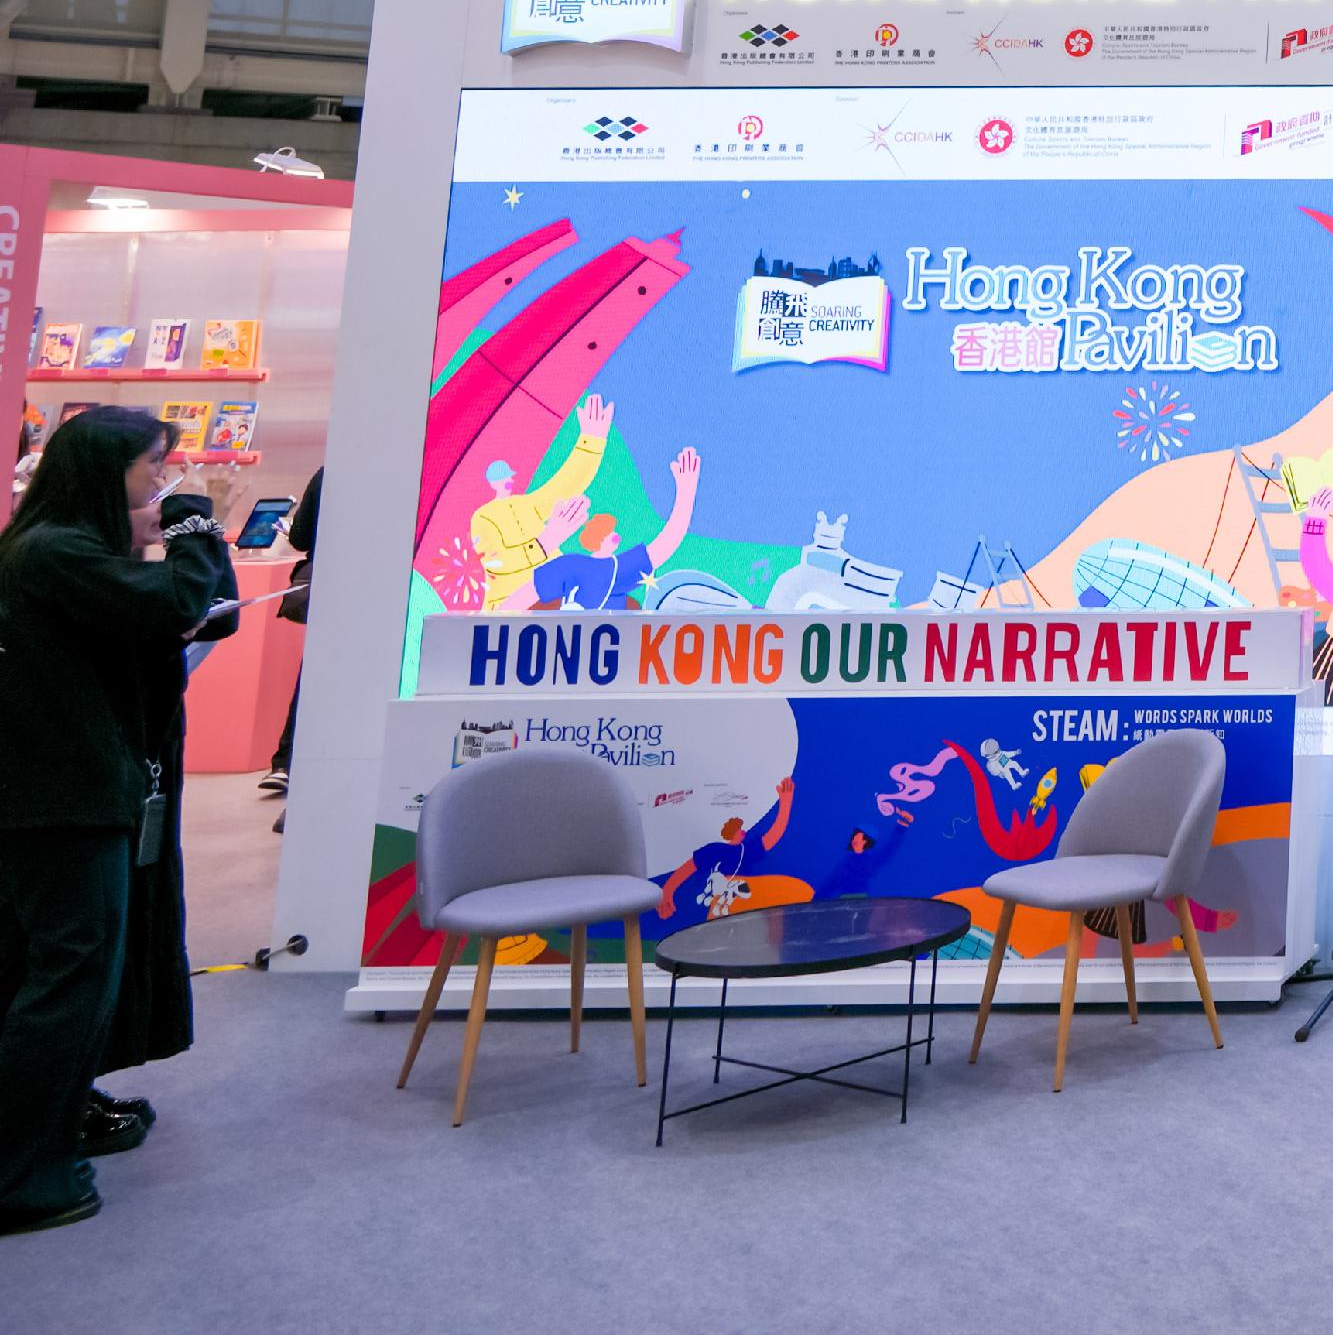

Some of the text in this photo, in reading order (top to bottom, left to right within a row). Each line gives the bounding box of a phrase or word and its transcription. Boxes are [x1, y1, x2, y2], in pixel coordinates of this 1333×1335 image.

[995, 39, 1044, 48] CCIDAHK
[894, 132, 953, 142] CCIDAHK
[904, 247, 1244, 318] Hong Kong
[810, 305, 862, 318] SOARING
[808, 319, 876, 333] CREATIVITY
[956, 324, 1060, 370] 香港館
[469, 621, 1253, 686] HONG KONG OUR NARRATIVE
[1134, 709, 1177, 724] WORDS
[1180, 709, 1220, 724] SPARK
[1223, 709, 1273, 724] WORLDS
[525, 716, 664, 747] Hong Kong
